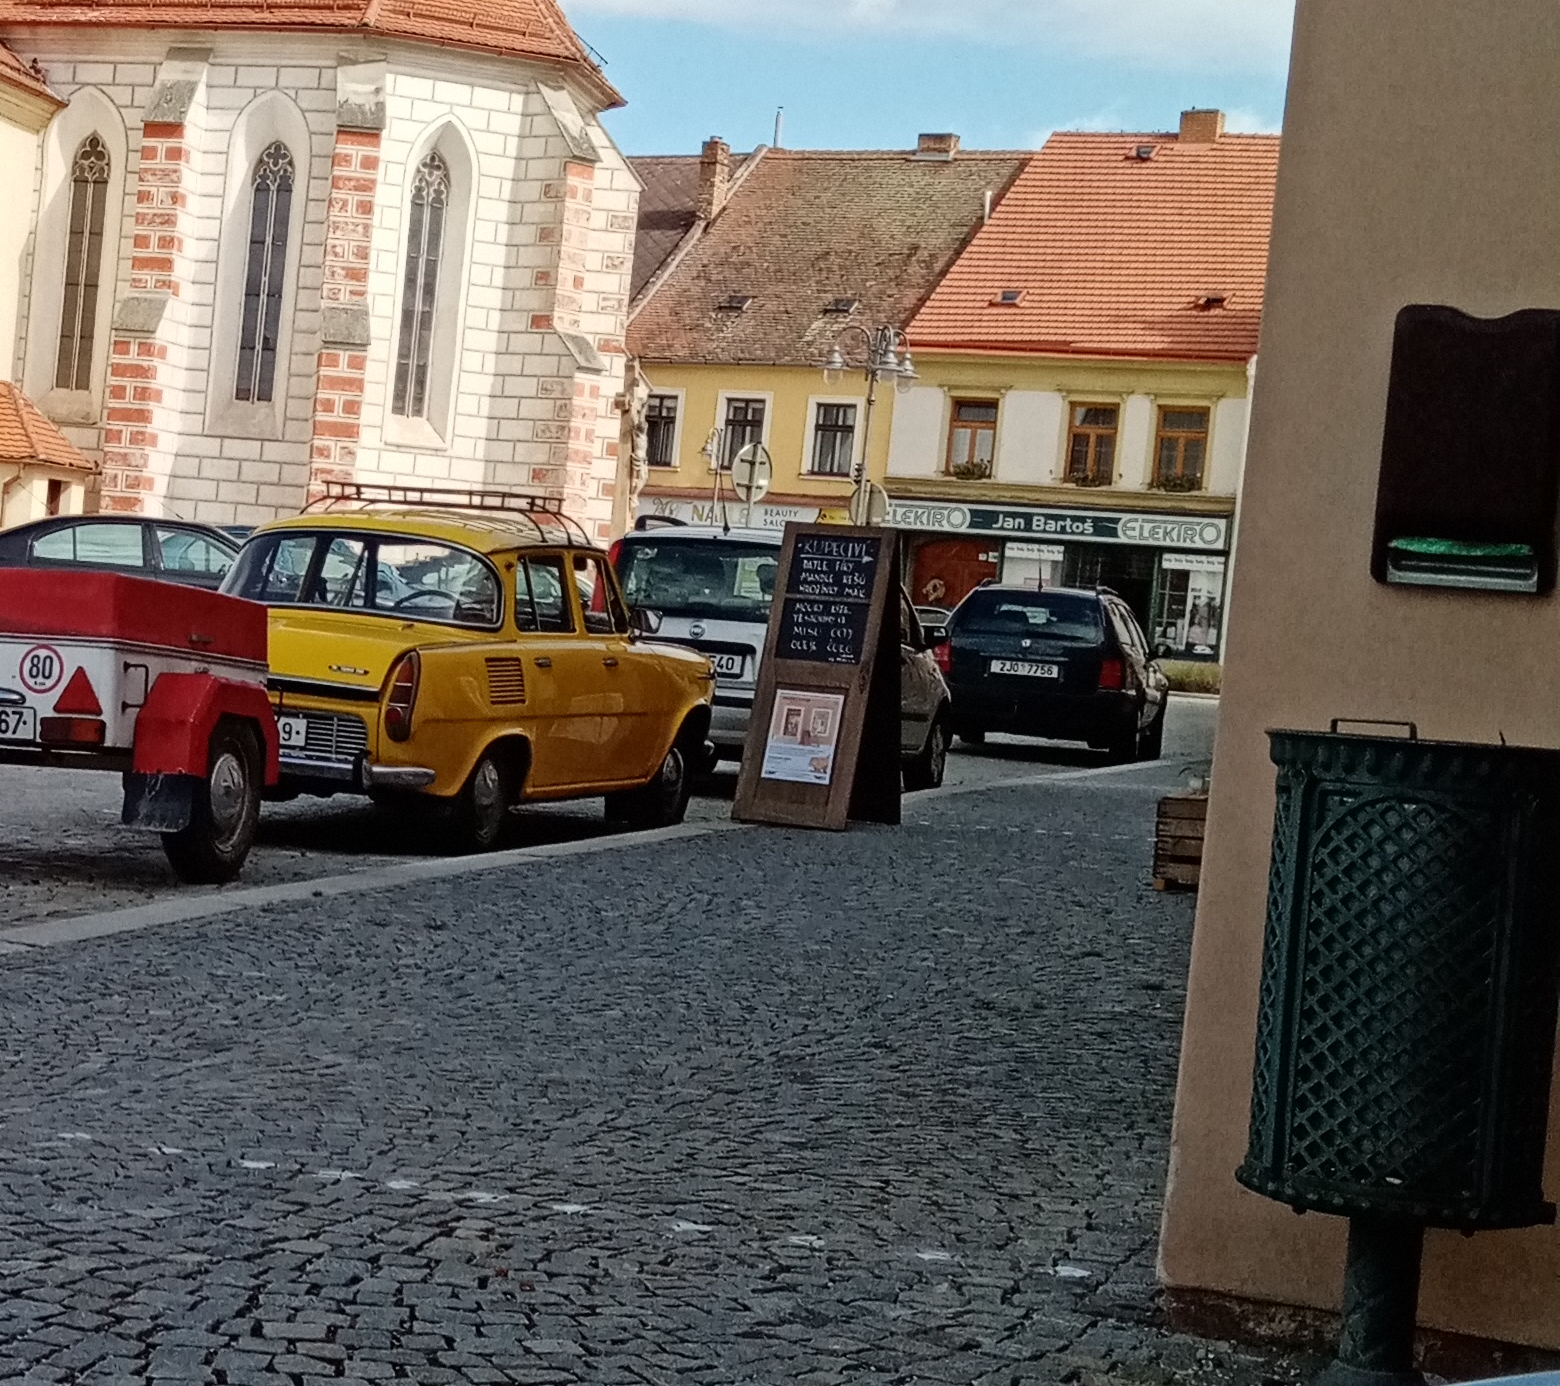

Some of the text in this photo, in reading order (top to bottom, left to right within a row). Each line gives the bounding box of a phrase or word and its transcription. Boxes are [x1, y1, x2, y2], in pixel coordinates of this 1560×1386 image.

[764, 508, 799, 518] BEAUTY
[992, 513, 1094, 534] Jan Bartoš
[1121, 517, 1221, 545] ELEKTRO
[28, 654, 54, 680] 80
